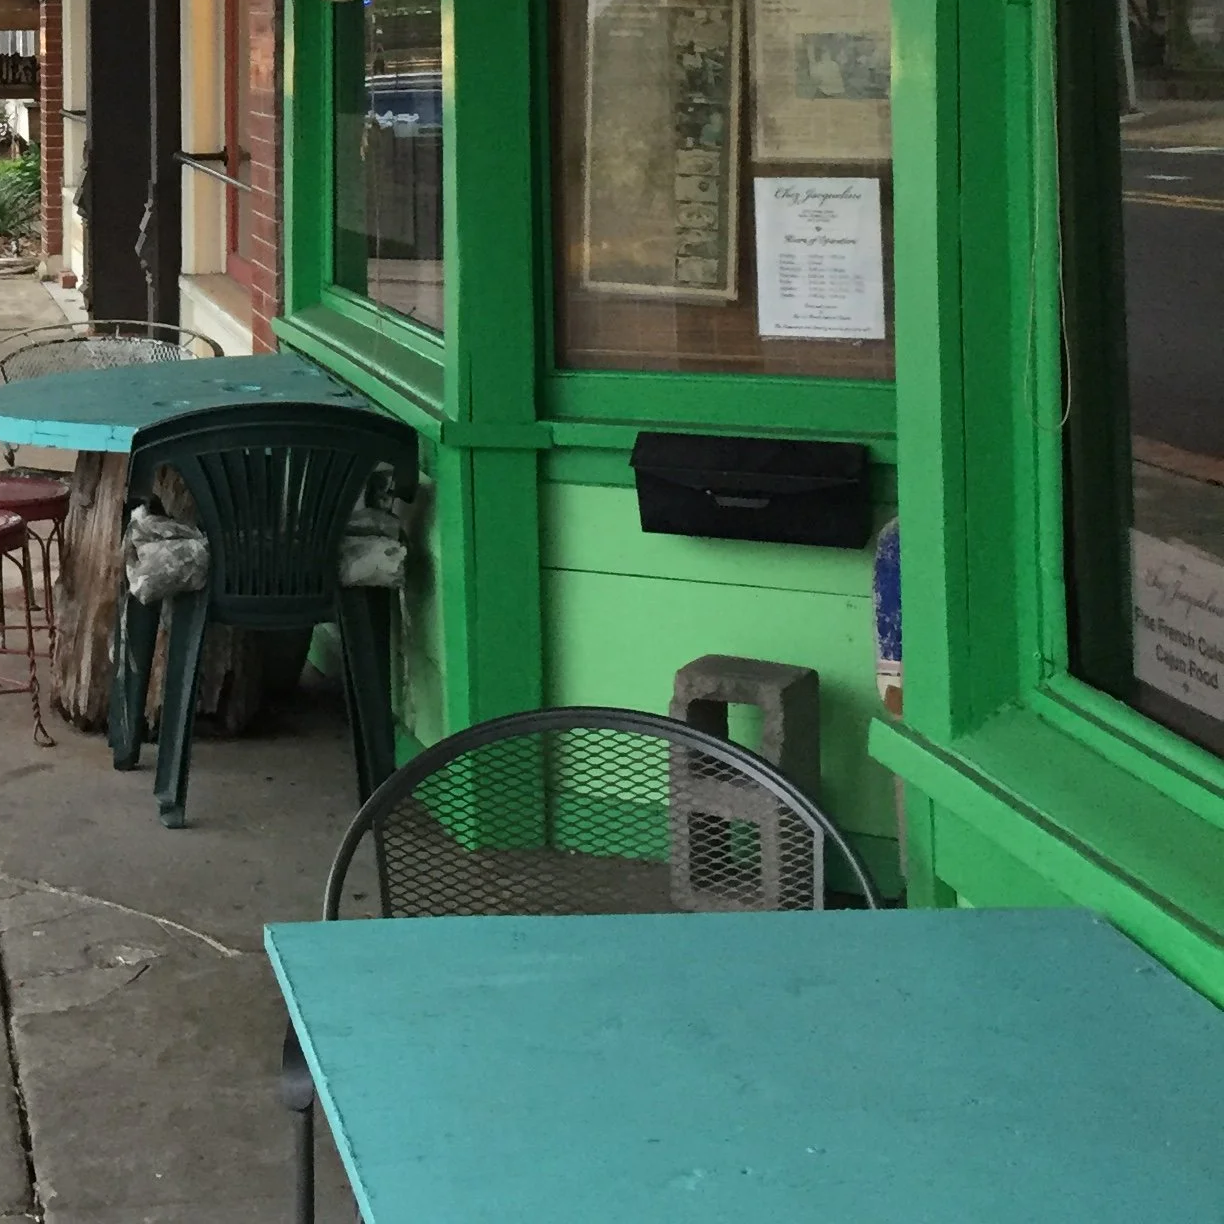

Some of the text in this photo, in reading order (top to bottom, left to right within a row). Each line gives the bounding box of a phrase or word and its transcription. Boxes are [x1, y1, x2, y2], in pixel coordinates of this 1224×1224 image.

[1157, 617, 1196, 650] French
[1156, 644, 1219, 689] Cajun Food
